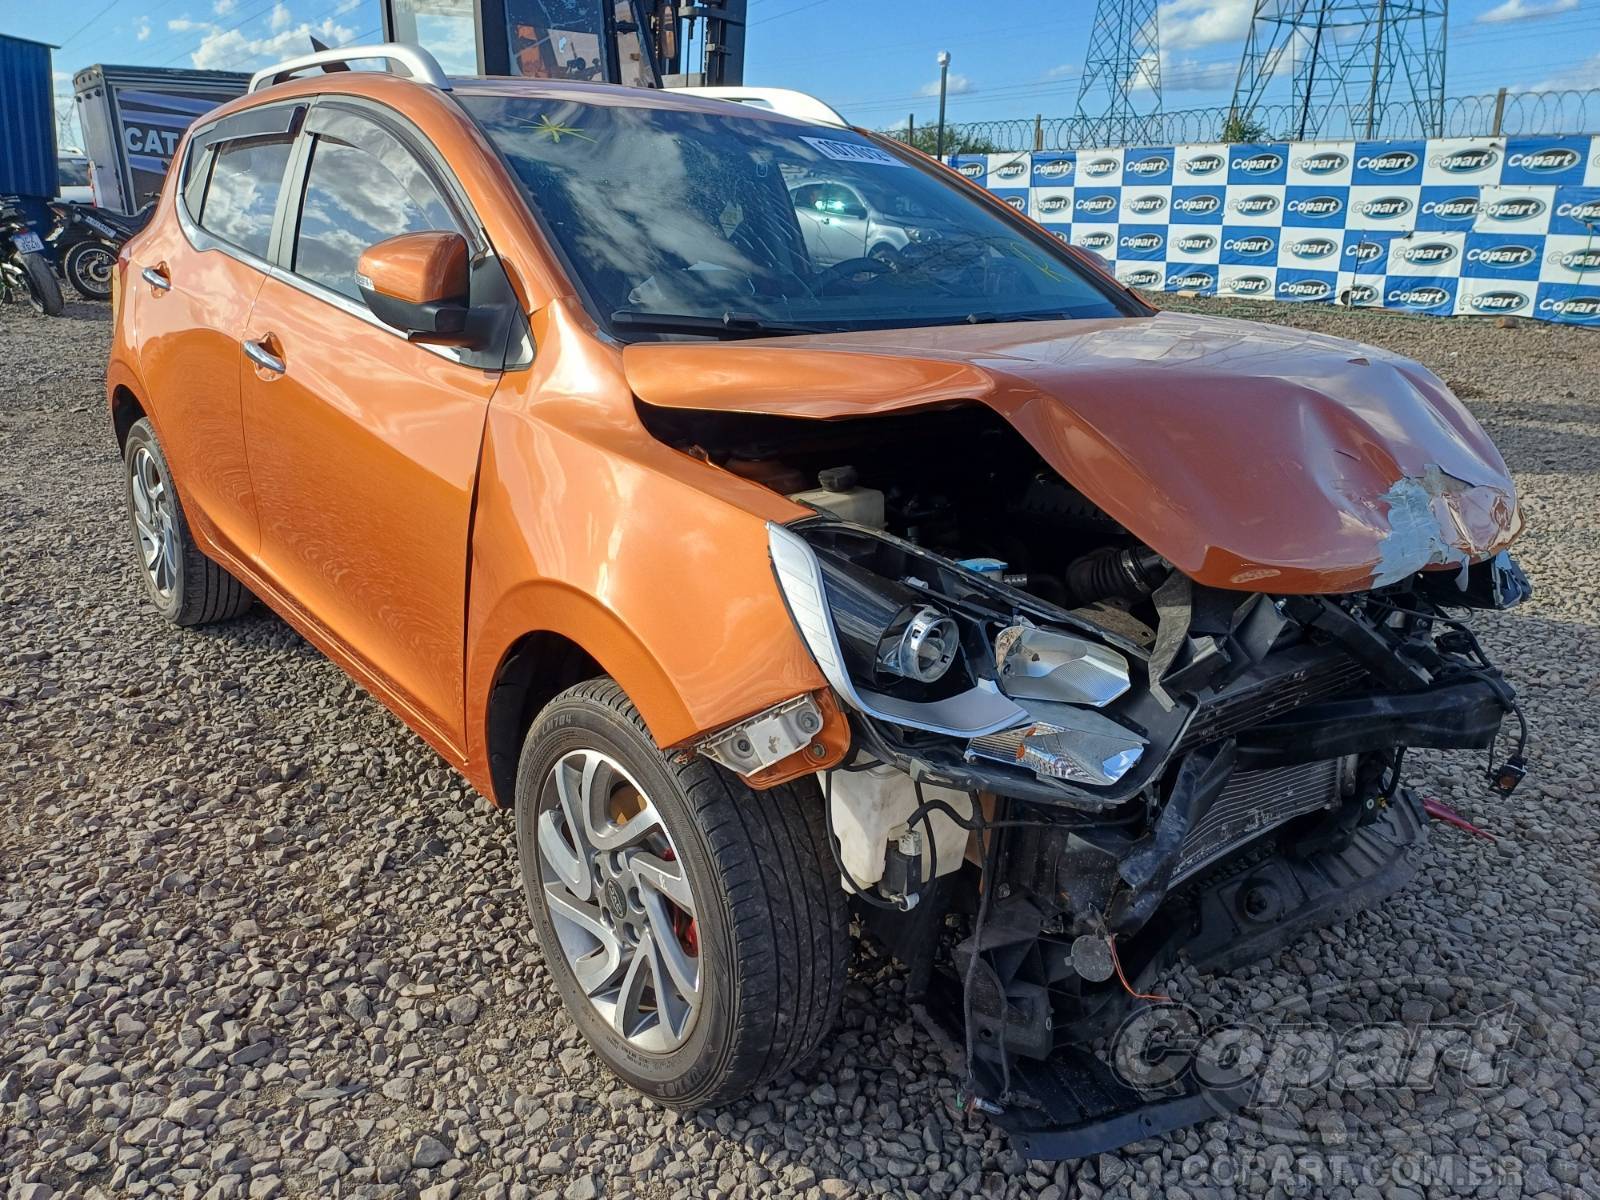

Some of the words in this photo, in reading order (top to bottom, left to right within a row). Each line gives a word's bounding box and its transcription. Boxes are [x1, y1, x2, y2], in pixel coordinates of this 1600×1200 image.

[1126, 160, 1165, 174] Copart
[1231, 157, 1278, 172] Copart
[1356, 155, 1412, 170] Copart
[1429, 153, 1489, 170] Copart
[1507, 153, 1573, 169] Copart
[1033, 161, 1068, 177] Copart
[1075, 199, 1113, 212] Copart
[1173, 198, 1215, 212] Copart
[1287, 199, 1337, 213] Copart
[1120, 236, 1159, 249] Copart
[1223, 238, 1269, 253] Copart
[1466, 248, 1529, 264] Copart
[1167, 275, 1210, 288] Copart
[1278, 281, 1326, 297] Copart
[1387, 290, 1443, 304] Copart
